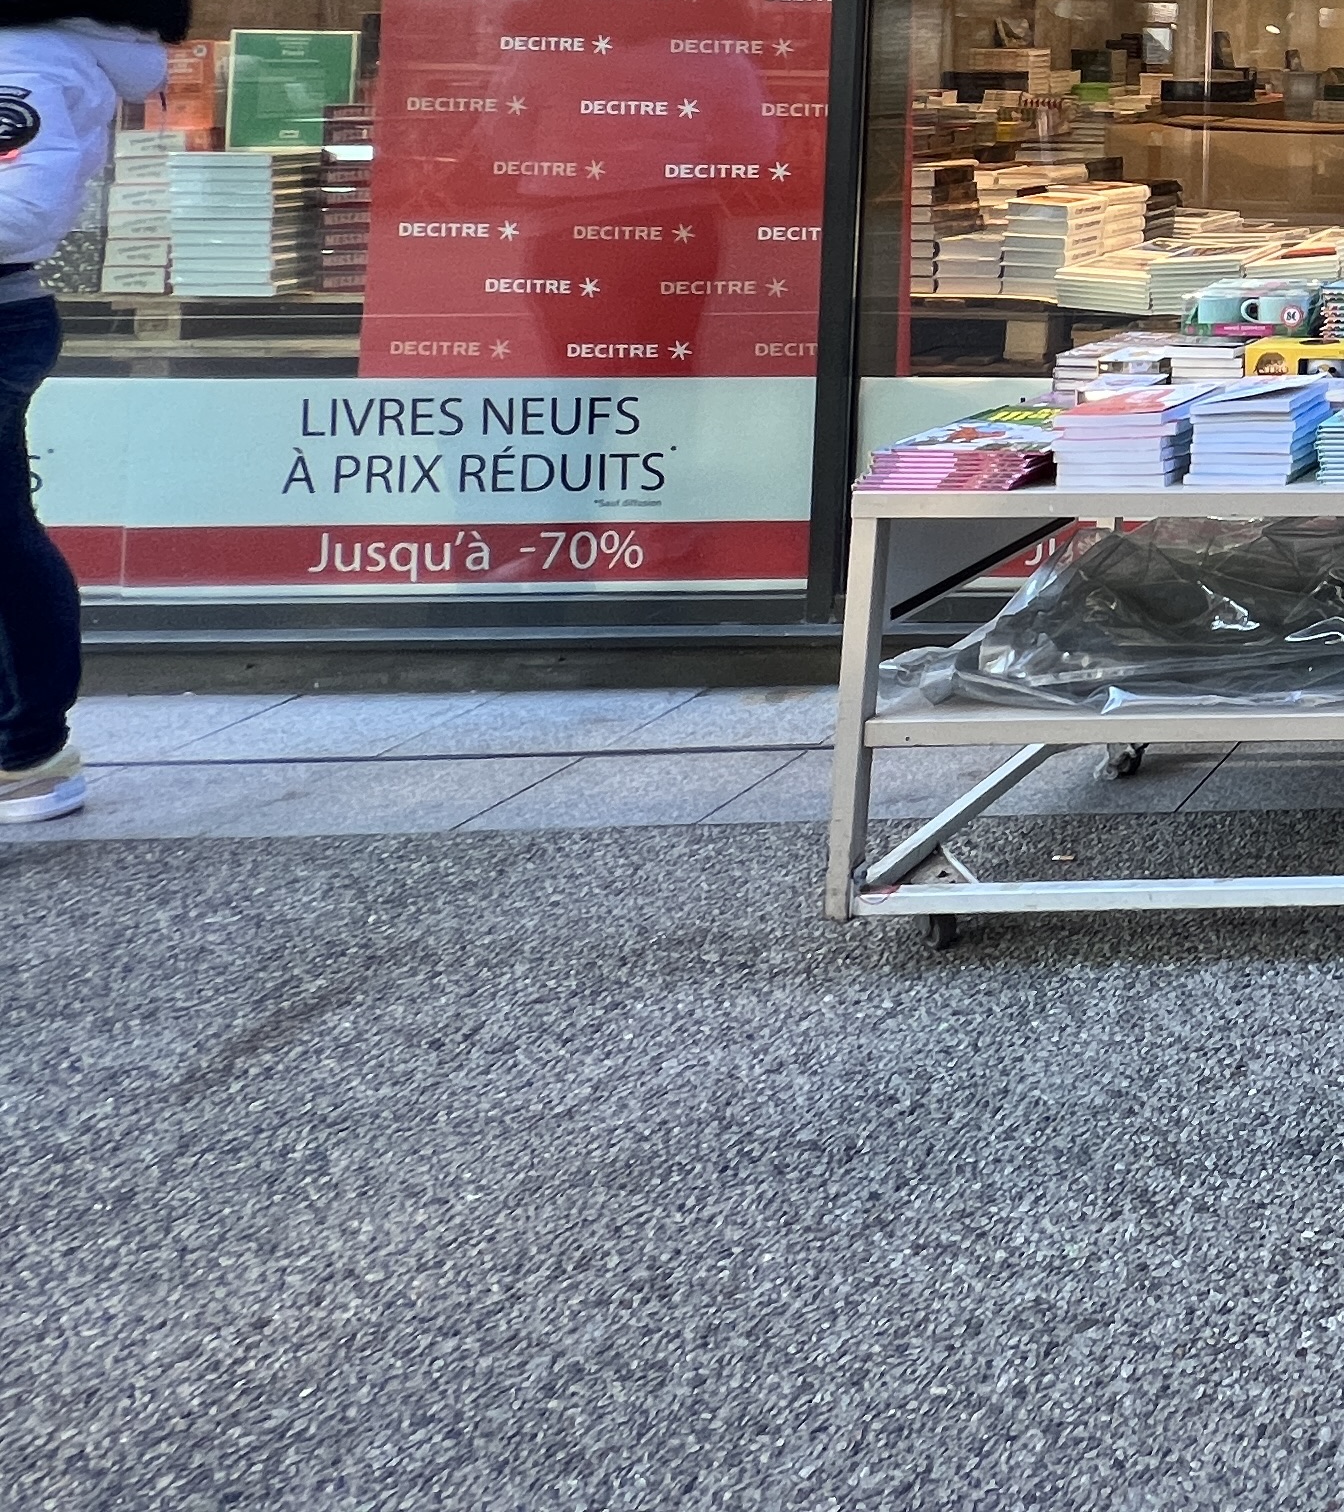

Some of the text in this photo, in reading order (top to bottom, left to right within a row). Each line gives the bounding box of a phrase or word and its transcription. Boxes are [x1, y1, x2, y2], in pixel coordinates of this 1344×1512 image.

[500, 36, 585, 52] DECITRE
[670, 39, 763, 56] DECITRE
[406, 96, 498, 113] DECITRE
[580, 99, 668, 116] DECITRE
[493, 160, 578, 177] DECITRE
[664, 162, 760, 180] DECITRE
[398, 222, 490, 239] DECITRE
[573, 224, 664, 242] DECITRE
[758, 226, 822, 243] DECIT
[485, 278, 571, 295] DECITRE
[660, 279, 757, 297] DECITRE
[1286, 311, 1298, 321] 8€
[390, 340, 481, 357] DECITRE
[567, 342, 658, 359] DECITRE
[755, 342, 818, 359] DECIT
[301, 395, 641, 439] LIVRES NEUFS
[281, 446, 316, 495] À
[334, 453, 442, 494] PRIX
[309, 530, 645, 582] Jusqu'à -70%
